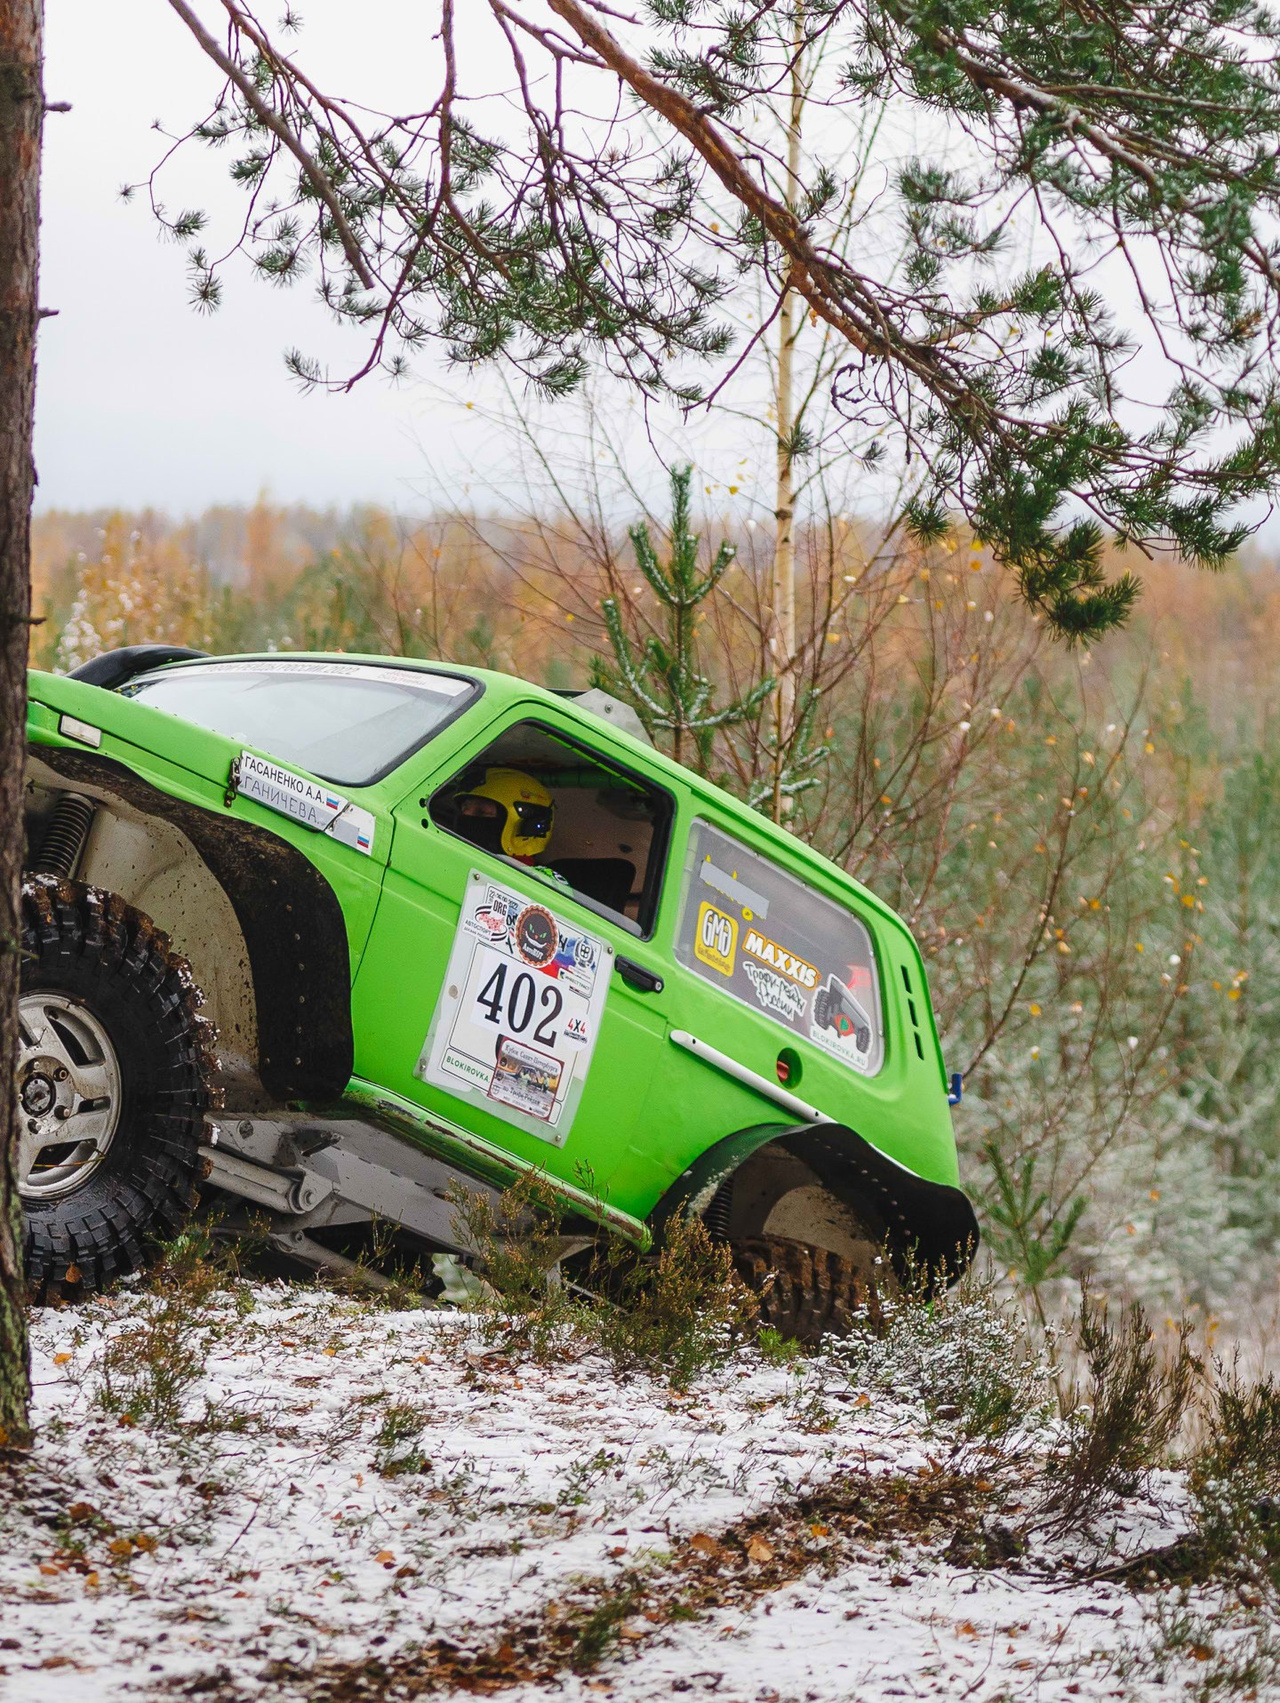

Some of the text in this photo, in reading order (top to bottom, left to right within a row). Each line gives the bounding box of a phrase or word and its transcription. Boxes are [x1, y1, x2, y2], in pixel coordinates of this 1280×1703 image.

[244, 755, 326, 804] ГАСАНЕНКО А.А.
[493, 899, 508, 916] ORG
[744, 932, 817, 988] MAXXIS
[476, 963, 564, 1049] 402
[812, 1030, 866, 1066] BLOKIROVKA.RU
